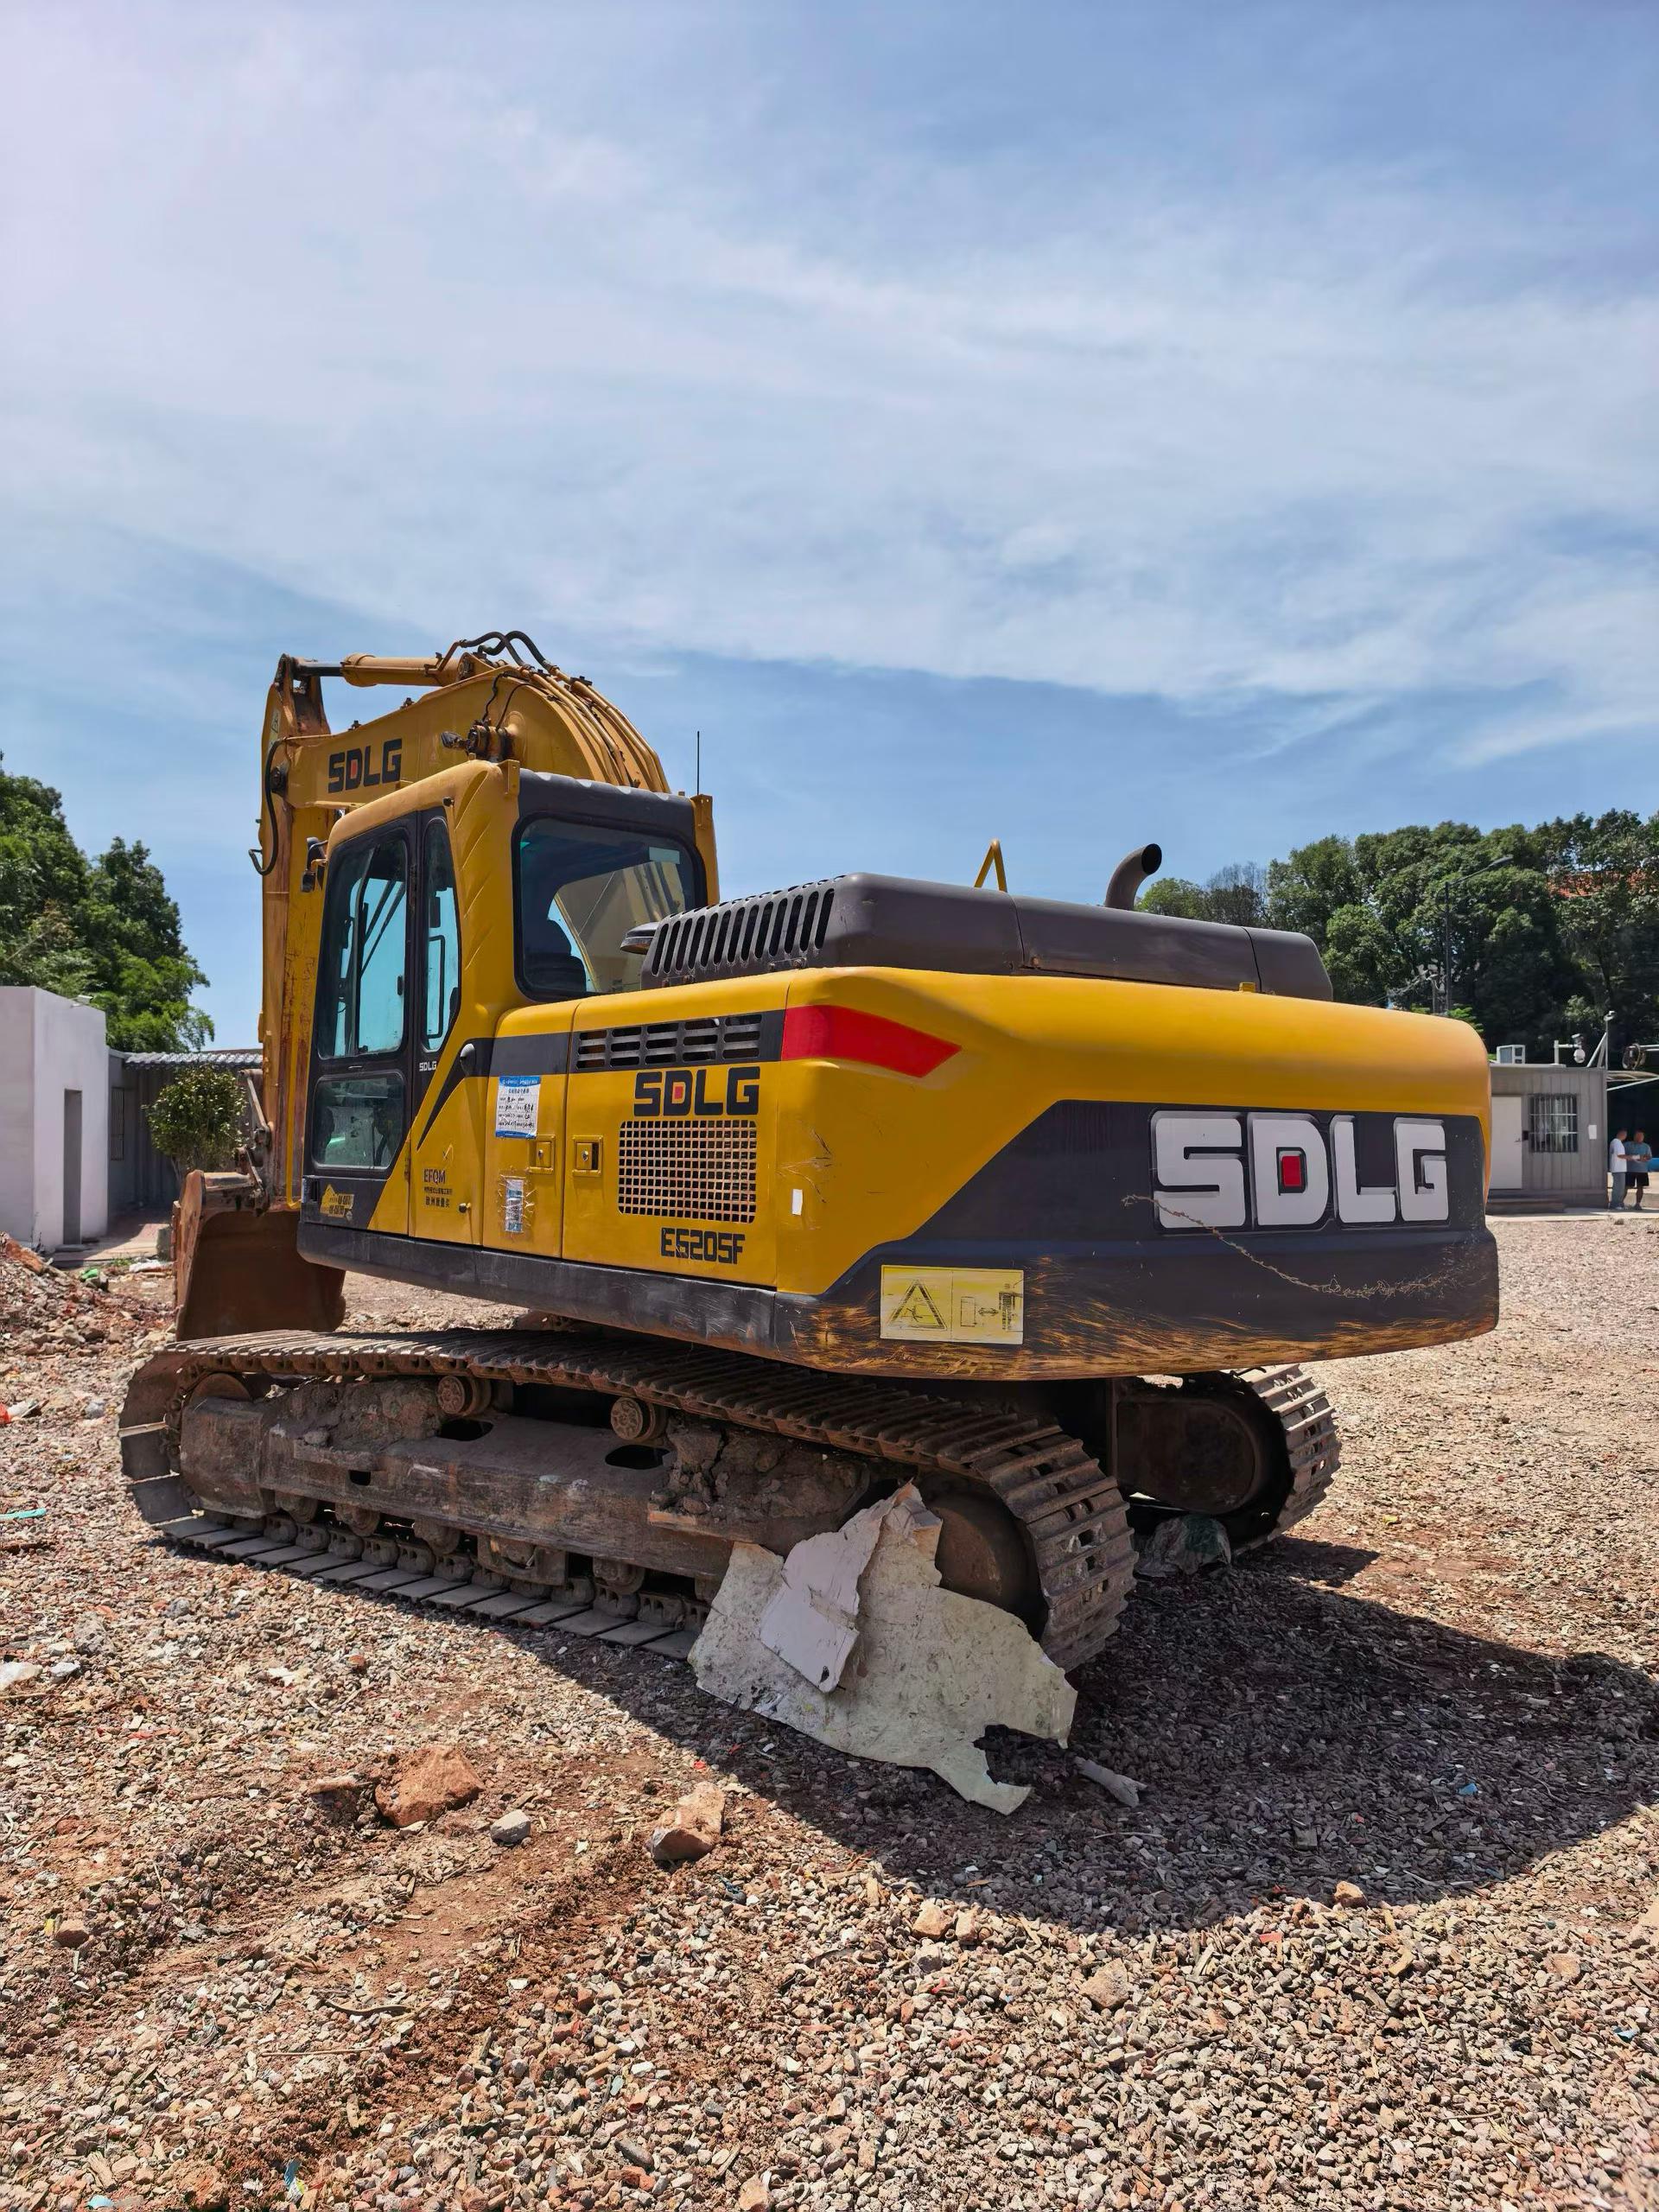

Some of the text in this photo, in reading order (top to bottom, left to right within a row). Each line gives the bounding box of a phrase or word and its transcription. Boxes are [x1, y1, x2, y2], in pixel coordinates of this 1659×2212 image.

[328, 738, 402, 793] SDLG
[419, 1061, 437, 1071] SDLG
[633, 1066, 760, 1116] SDLG
[423, 1168, 446, 1185] EFQM
[1152, 1110, 1449, 1229] SDLG
[661, 1227, 746, 1264] E6205F
